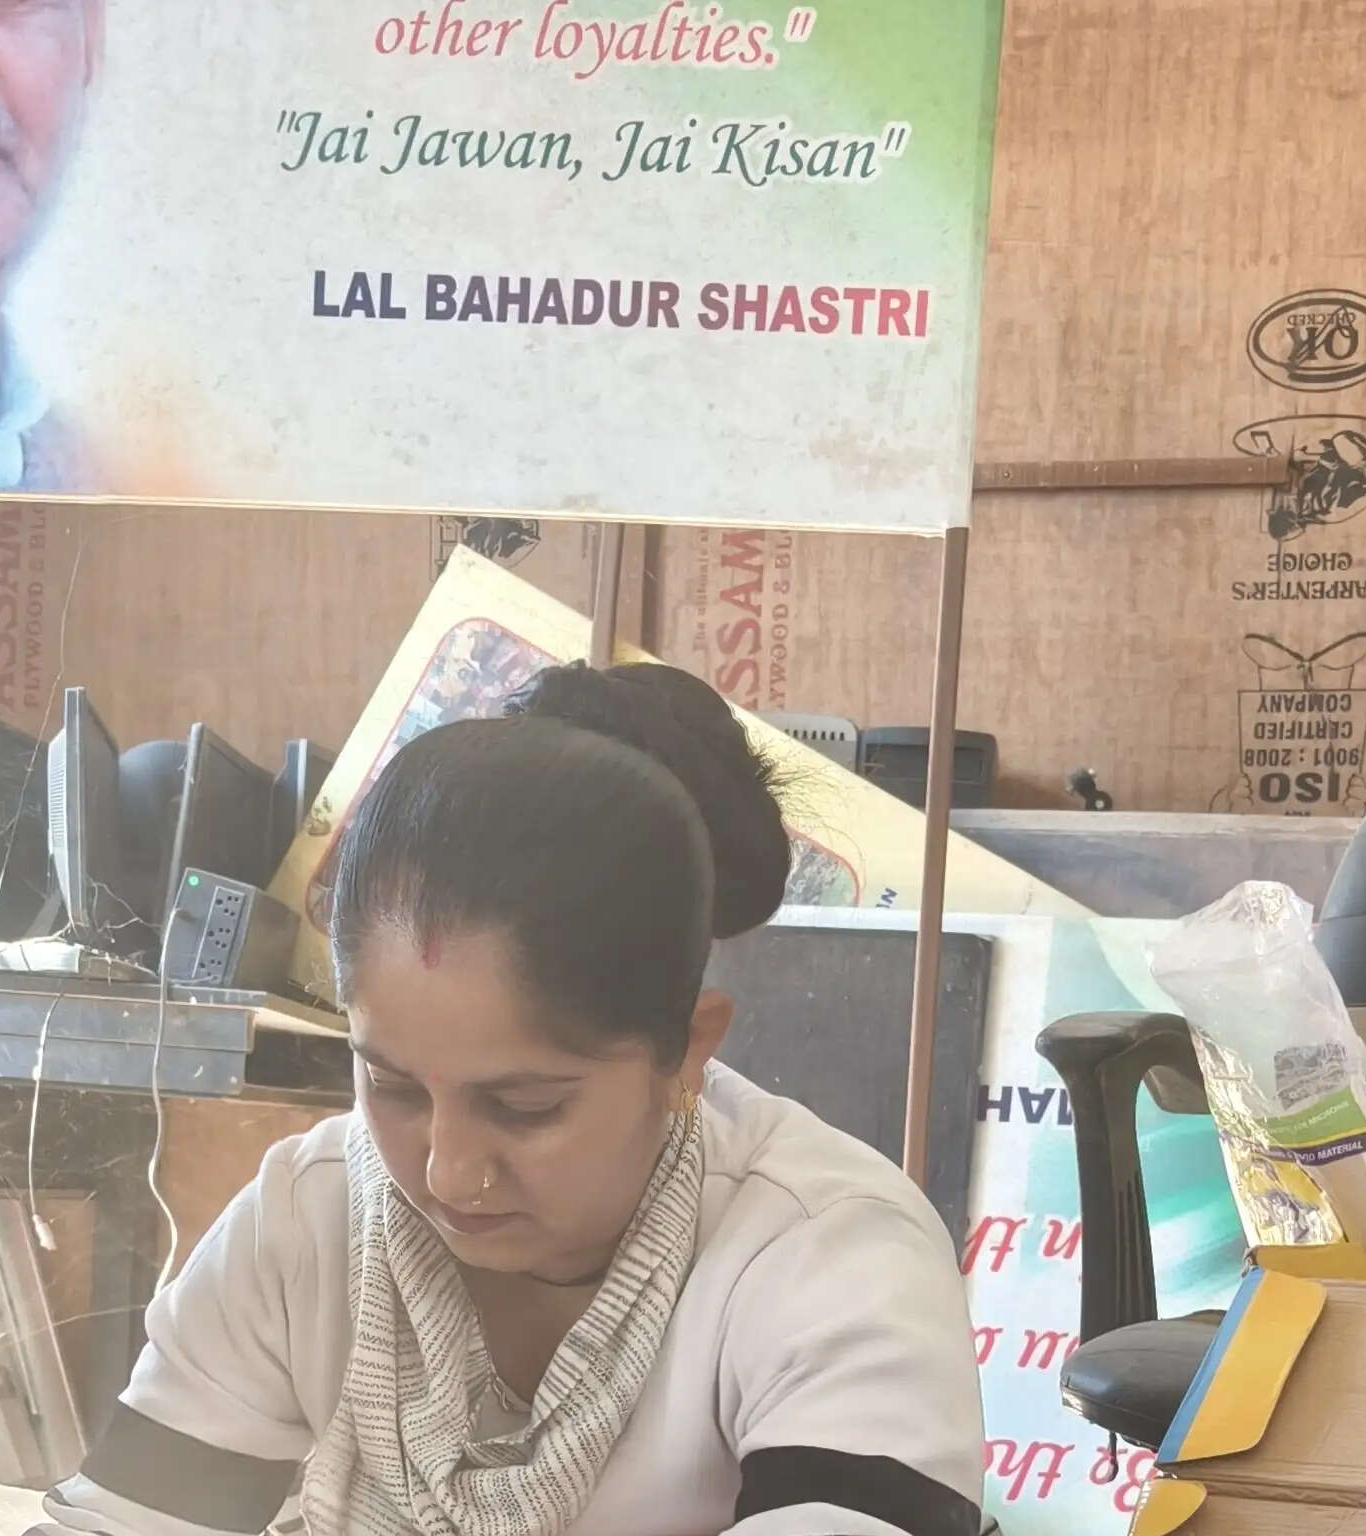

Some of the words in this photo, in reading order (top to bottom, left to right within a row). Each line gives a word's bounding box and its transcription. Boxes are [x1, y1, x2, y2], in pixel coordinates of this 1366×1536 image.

[375, 0, 523, 57] other
[534, 0, 811, 80] loyalties."
[276, 109, 374, 171] "Jai
[380, 115, 584, 181] Jawan,
[602, 119, 698, 182] Jai
[712, 121, 906, 187] Kisan"
[312, 270, 407, 320] LAL
[424, 273, 681, 329] BAHADUR
[697, 281, 930, 338] SHASTRI
[1287, 312, 1356, 327] CHECKED
[1286, 326, 1359, 361] OK
[1267, 552, 1353, 572] CHOICE
[715, 530, 765, 710] SSAM
[768, 604, 789, 710] YWOOD
[1257, 693, 1352, 713] COMPANY
[1253, 720, 1353, 740] CERTIFIED
[1244, 748, 1292, 767] 2008
[1313, 748, 1359, 767] 9001
[1259, 772, 1340, 803] ISO
